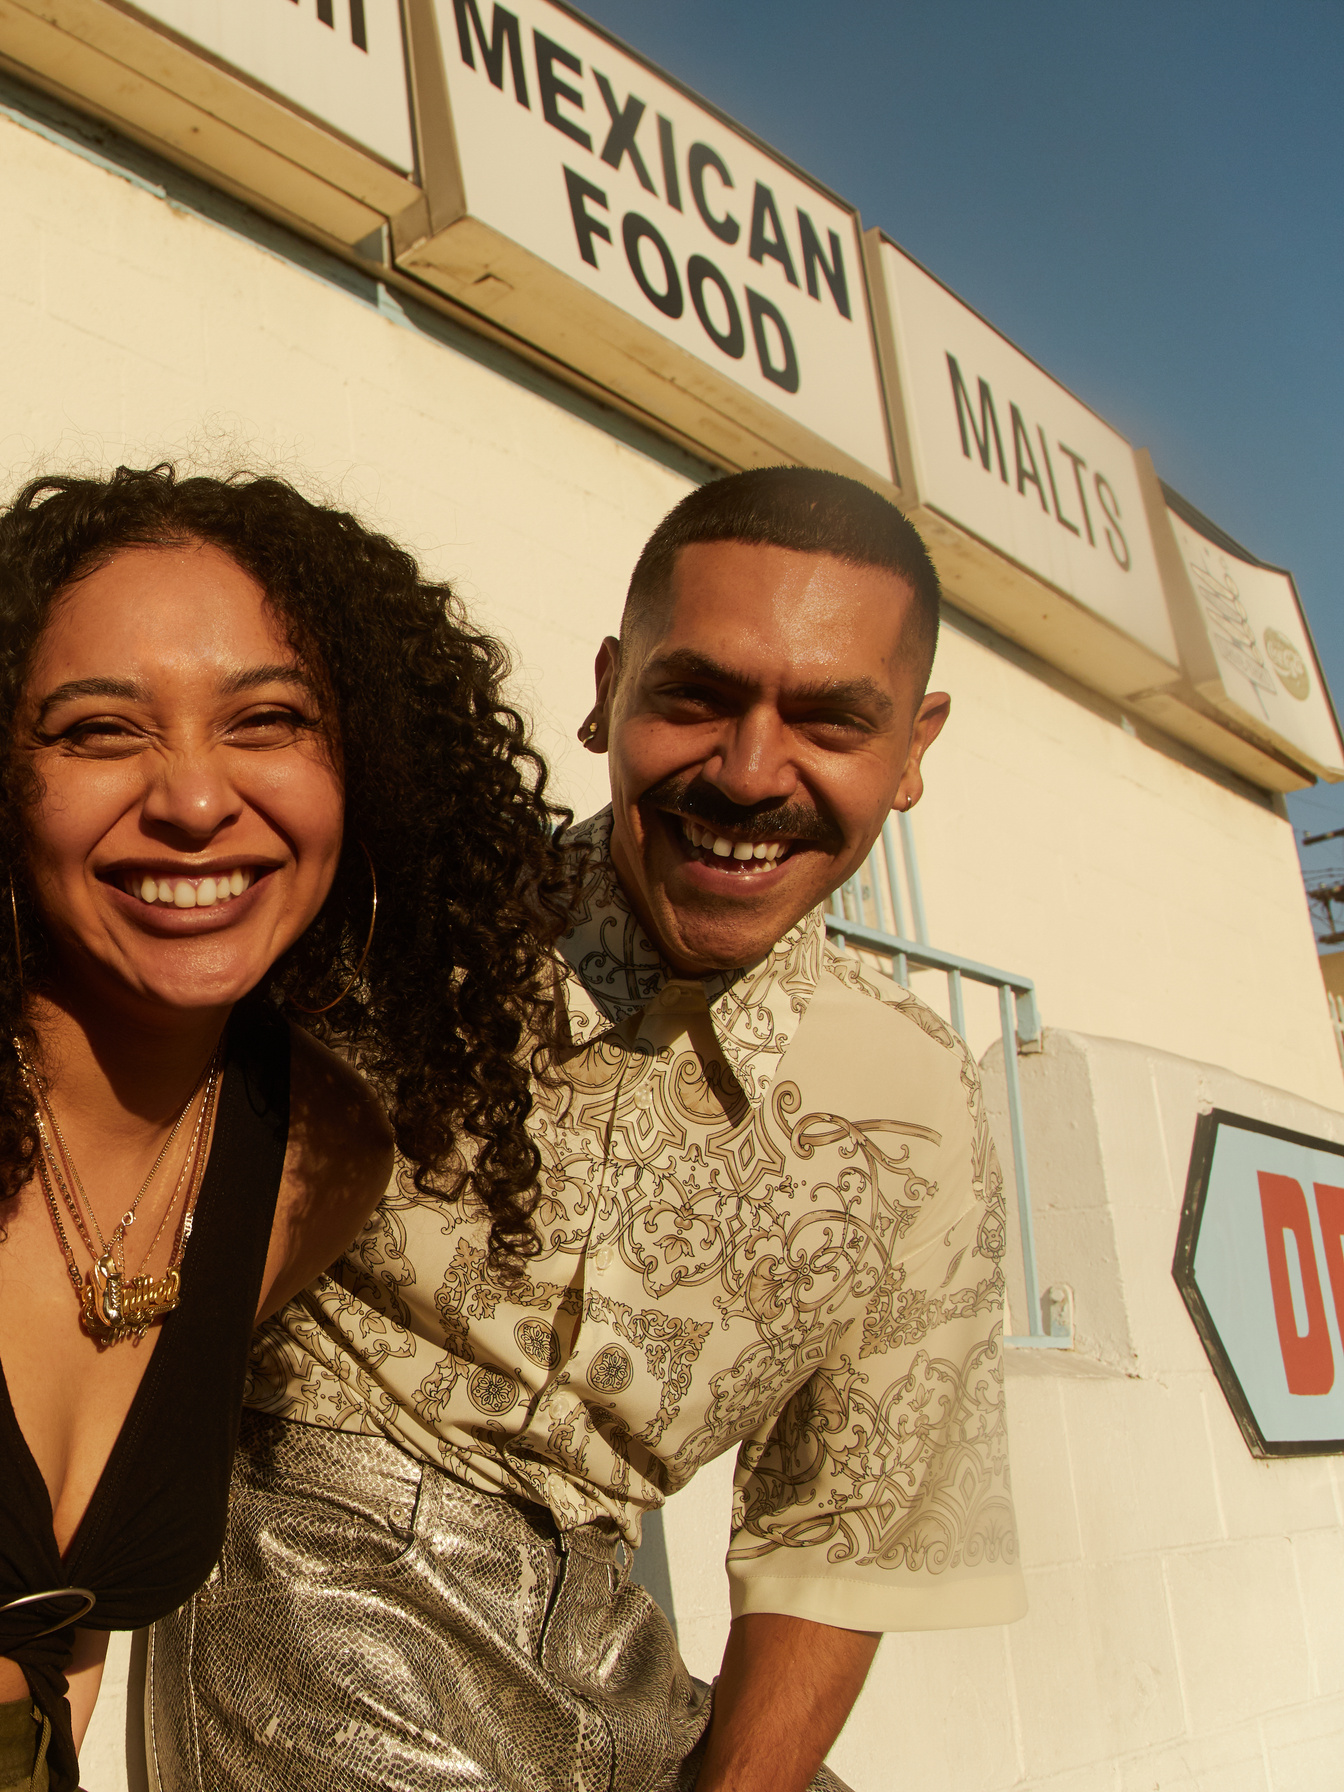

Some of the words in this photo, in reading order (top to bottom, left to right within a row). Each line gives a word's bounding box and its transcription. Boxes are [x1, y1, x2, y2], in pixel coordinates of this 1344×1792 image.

[452, 0, 852, 321] MEXICAN
[562, 164, 800, 394] FOOD
[945, 351, 1131, 572] MALTS
